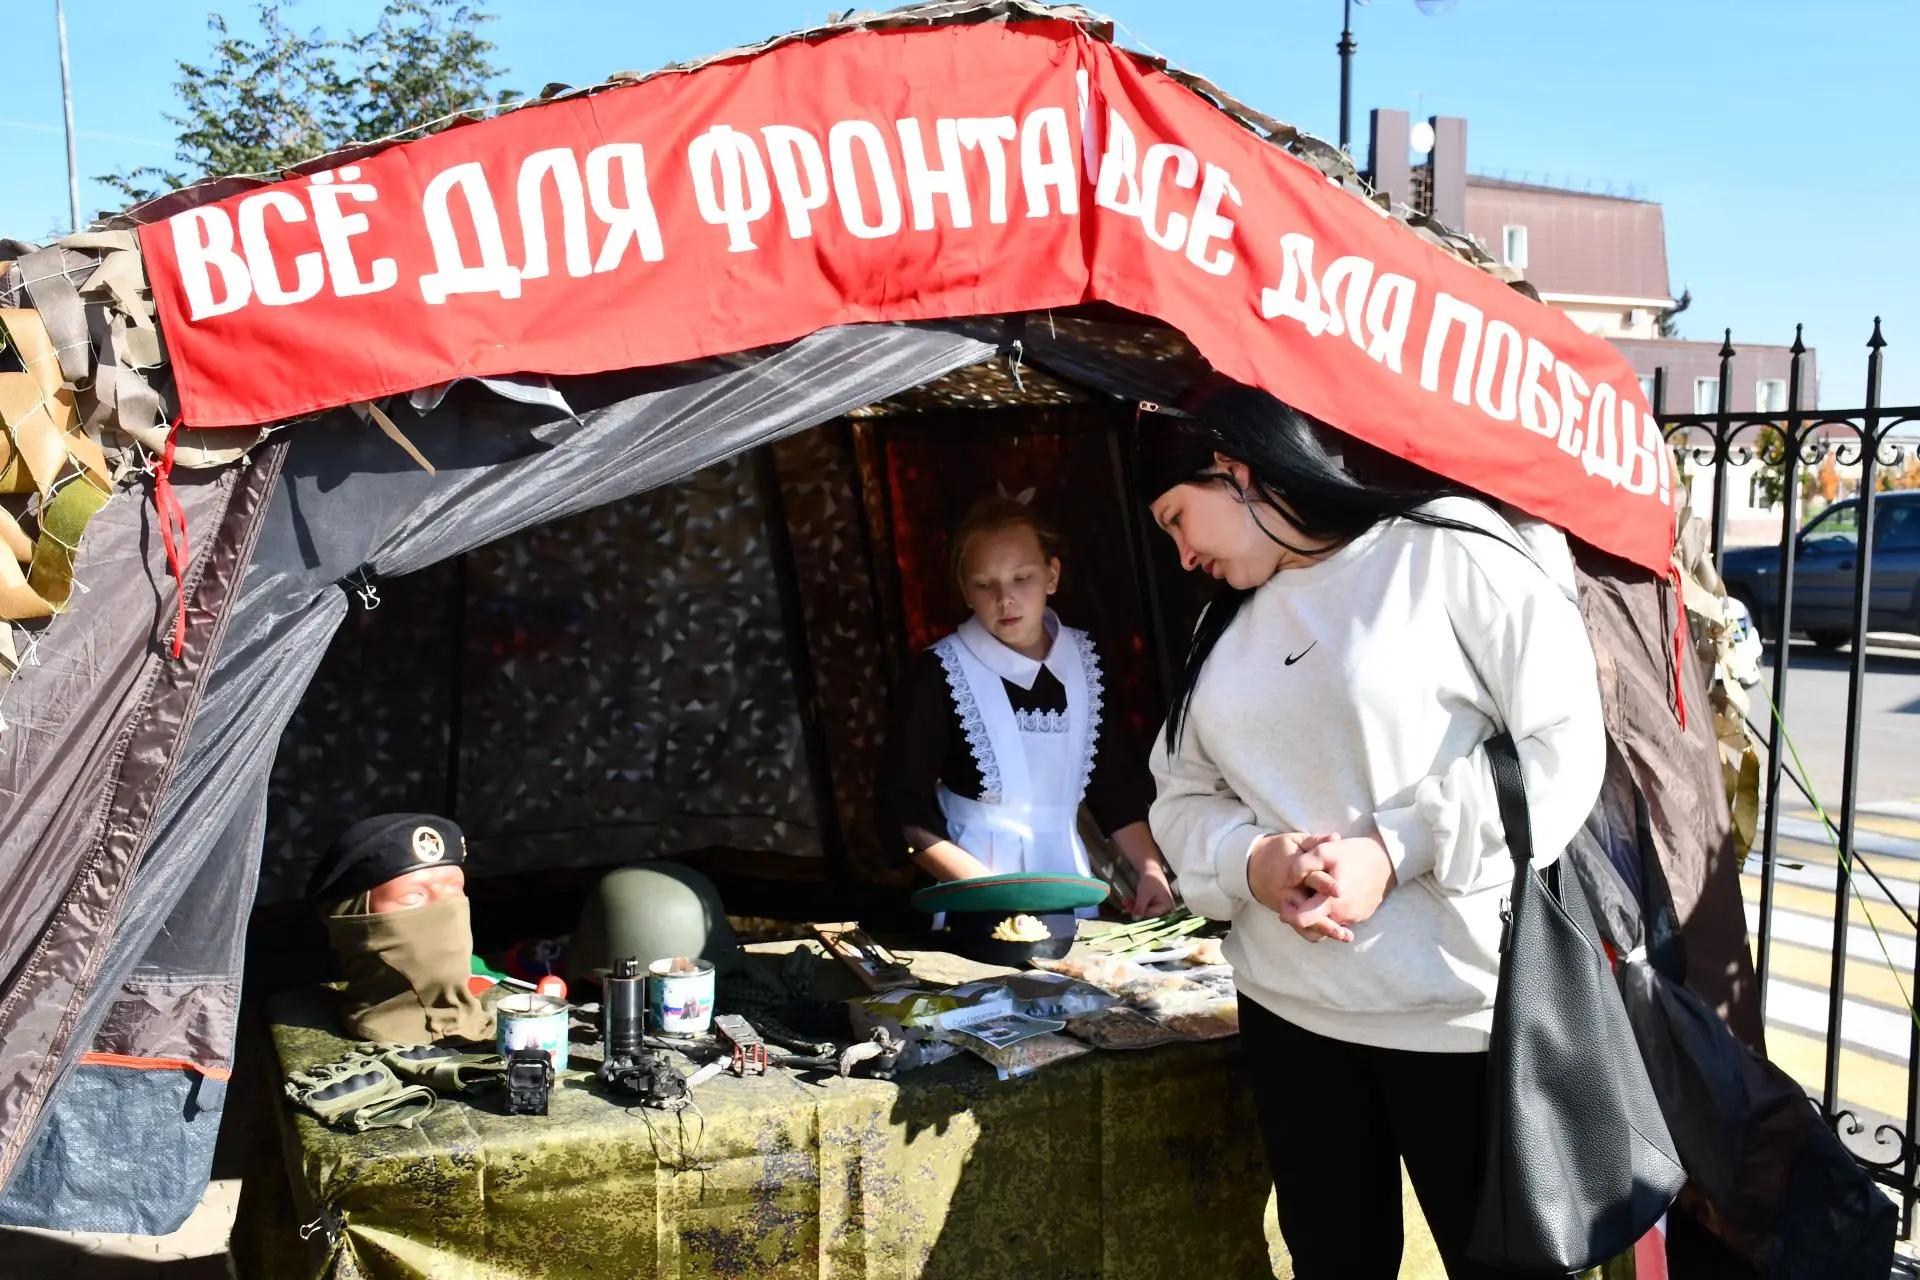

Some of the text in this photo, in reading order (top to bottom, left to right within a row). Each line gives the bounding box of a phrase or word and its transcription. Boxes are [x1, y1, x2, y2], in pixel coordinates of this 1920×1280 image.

[169, 165, 399, 322] ВСЁ
[418, 142, 665, 306] ДЛЯ
[1261, 232, 1418, 375] ДЛЯ
